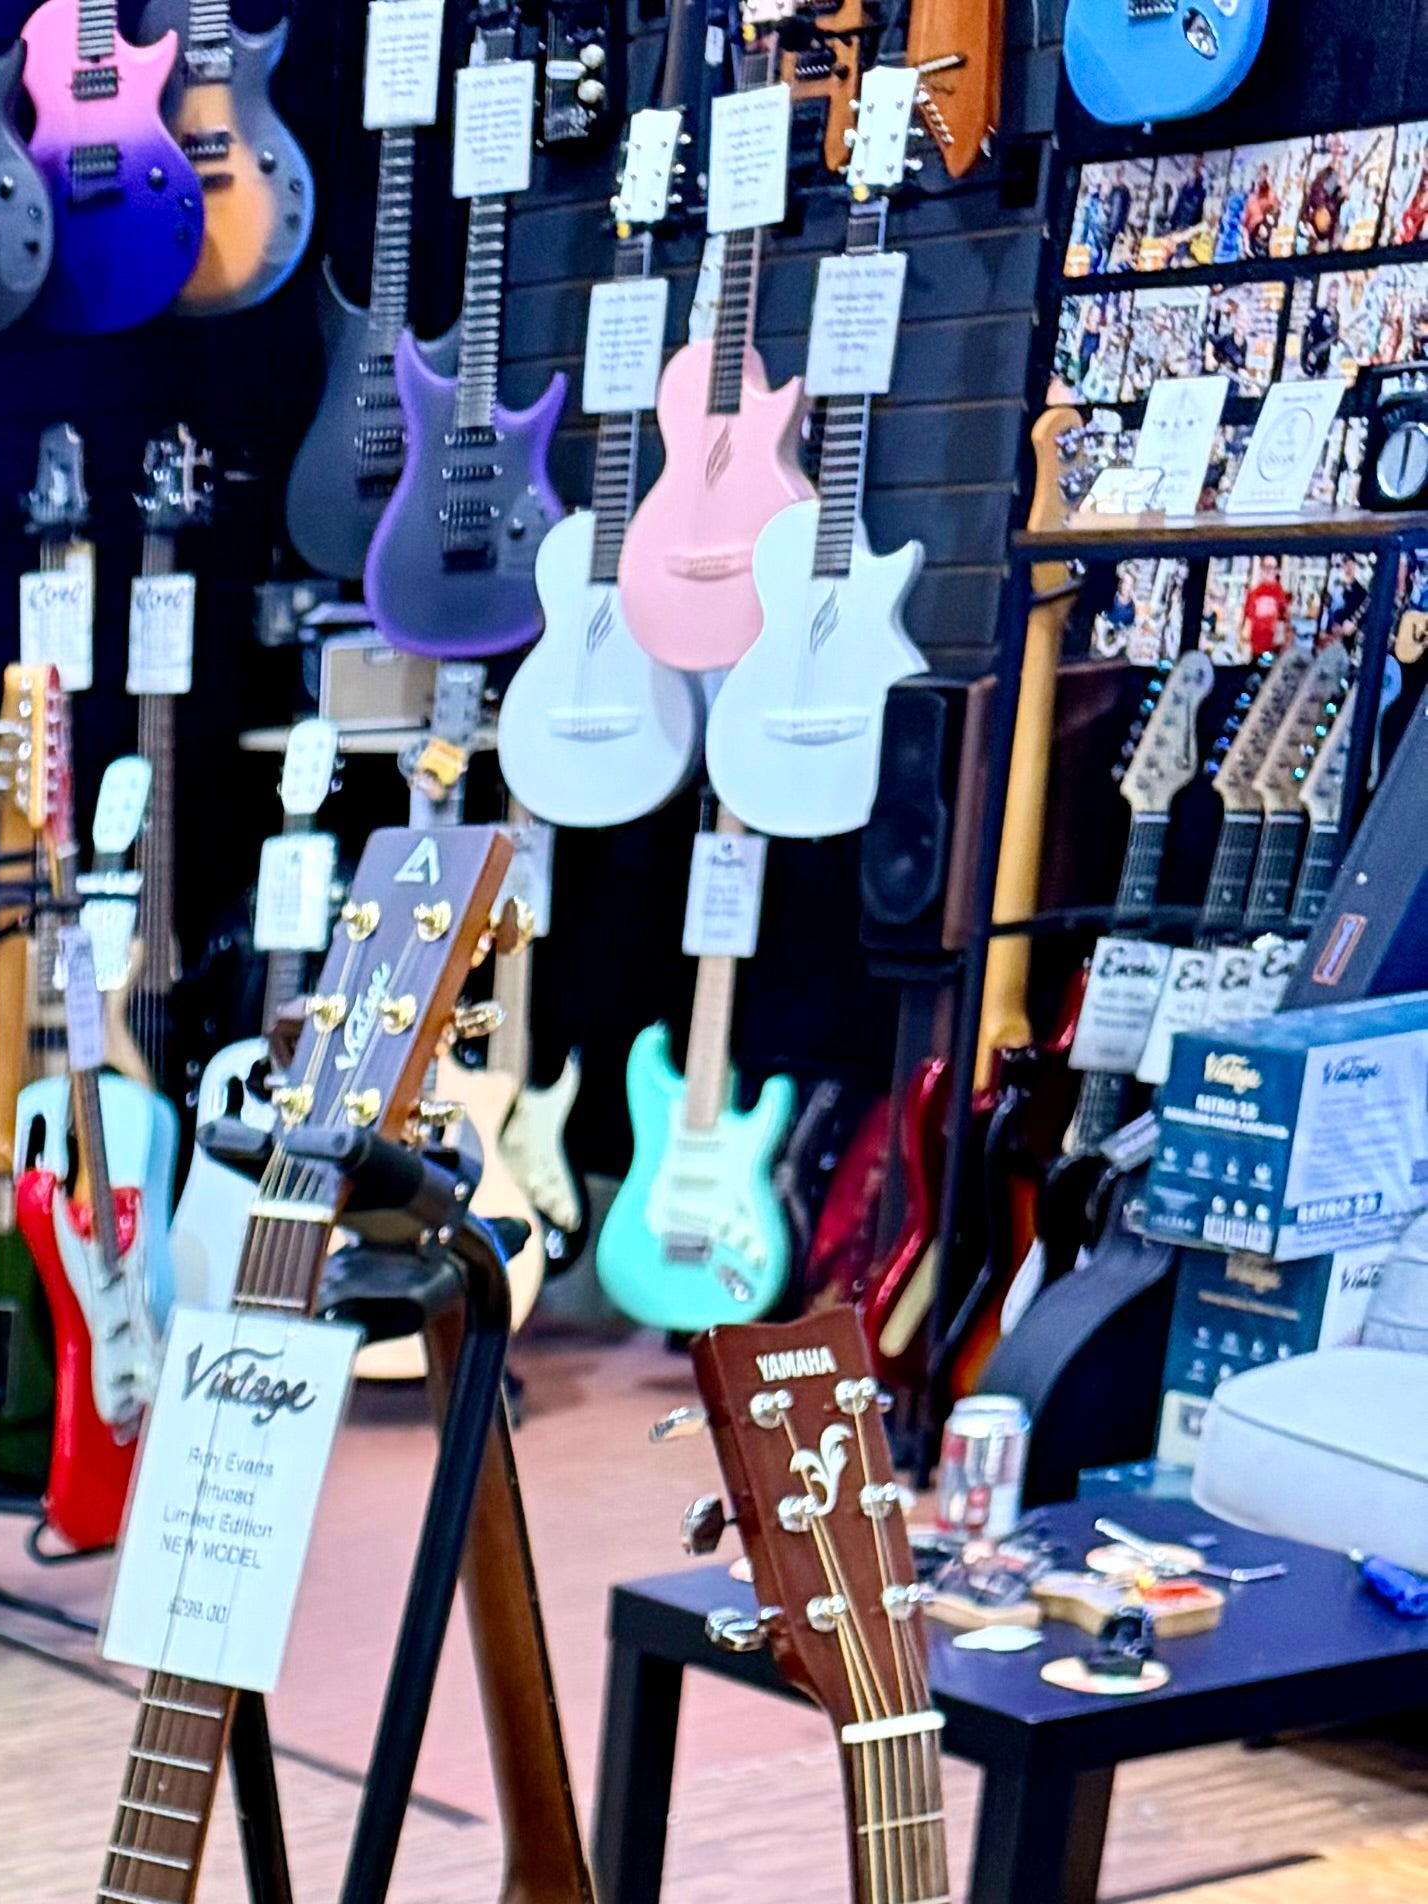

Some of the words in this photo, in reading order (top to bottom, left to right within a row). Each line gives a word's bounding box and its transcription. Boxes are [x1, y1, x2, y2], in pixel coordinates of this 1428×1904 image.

[756, 1346, 838, 1382] YAMAHA
[182, 1343, 316, 1426] Vintage
[219, 1515, 272, 1538] Edition
[202, 1543, 262, 1569] MODEL
